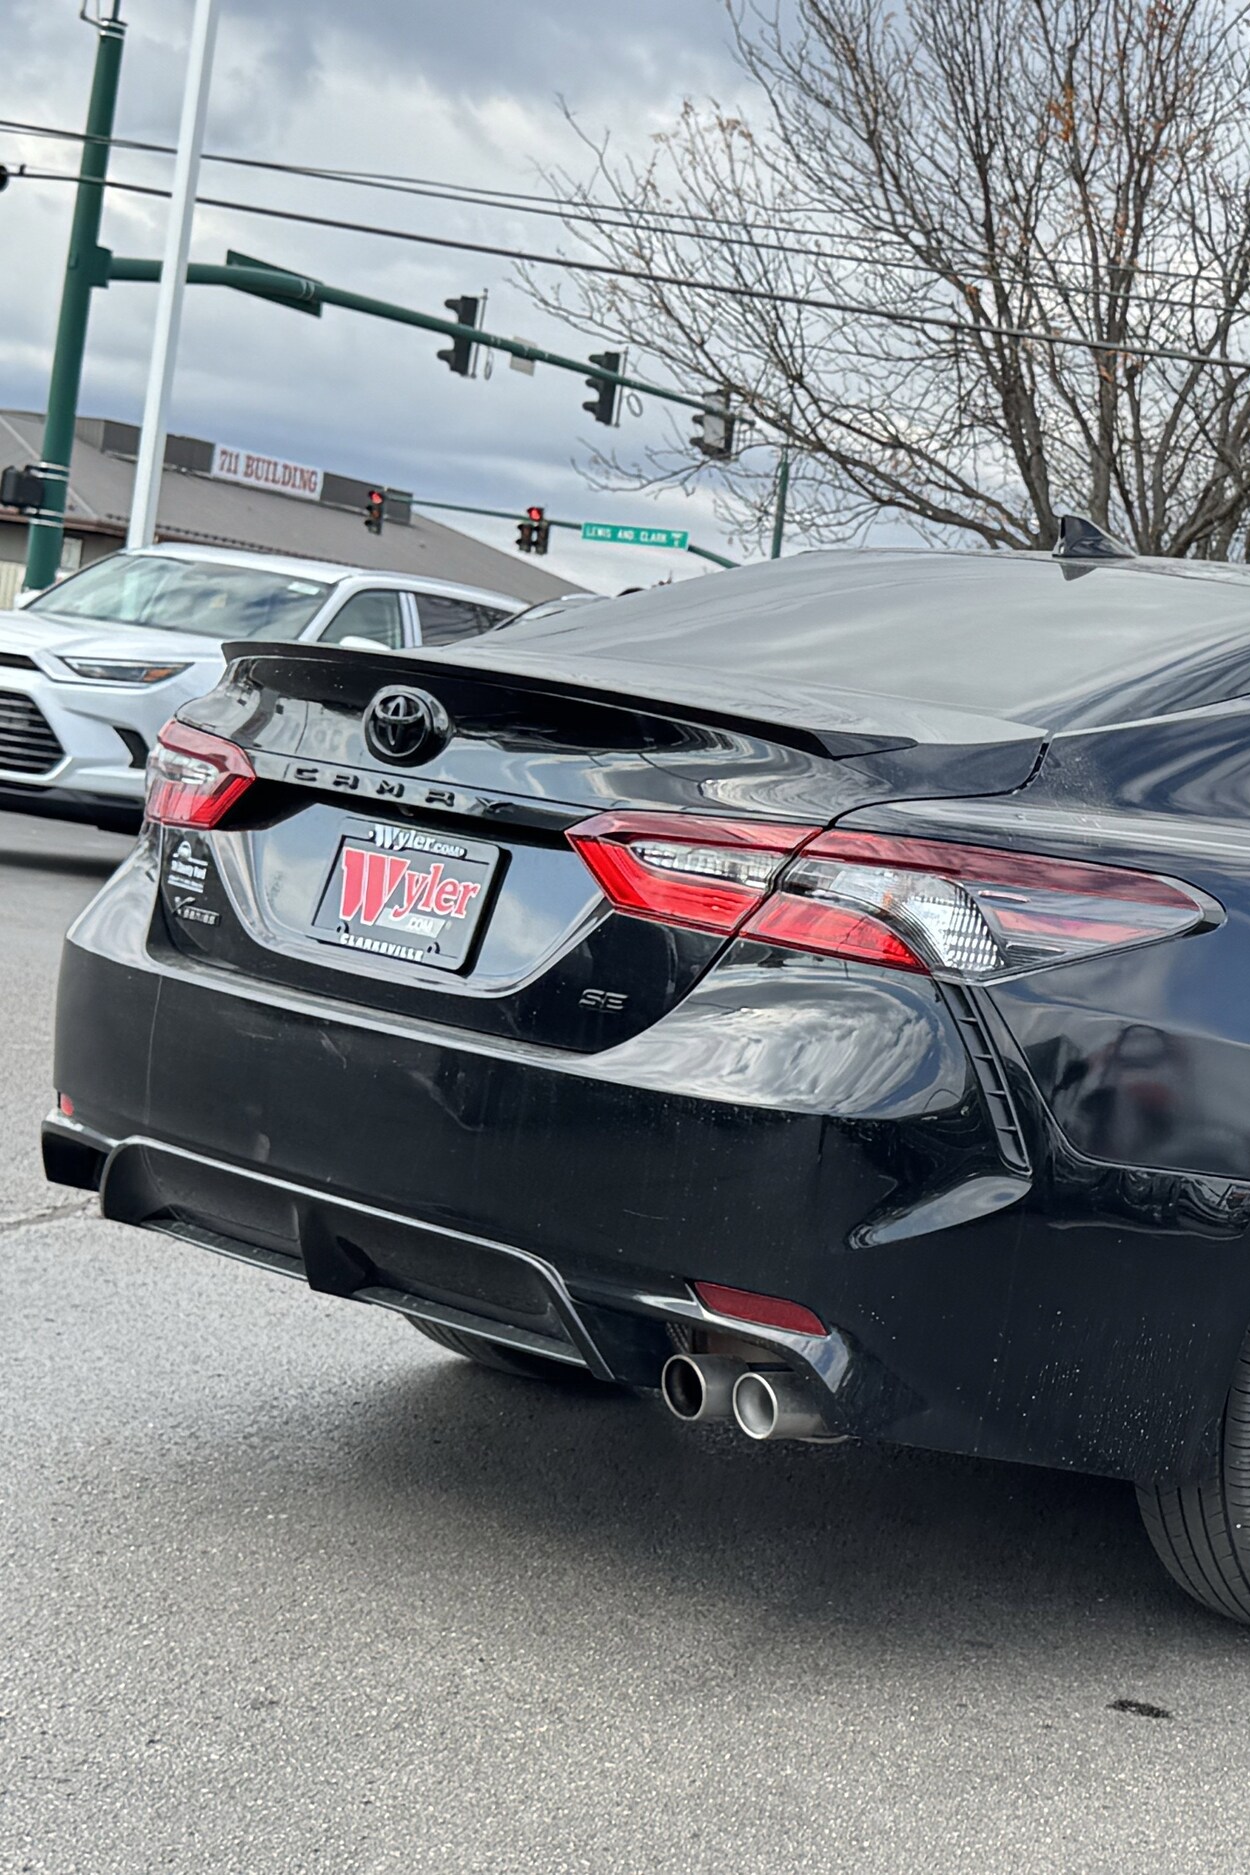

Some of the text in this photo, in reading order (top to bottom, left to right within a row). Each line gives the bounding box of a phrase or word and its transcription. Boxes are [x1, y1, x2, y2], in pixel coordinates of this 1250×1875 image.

[219, 449, 319, 493] 711 BUILDING
[585, 525, 612, 539] LEWIS
[617, 528, 635, 541] AND
[640, 530, 667, 544] CLARK
[294, 767, 516, 814] CAMRY
[339, 846, 481, 926] Wyler
[340, 932, 424, 962] CLARKSVILLE
[578, 988, 629, 1010] SE
